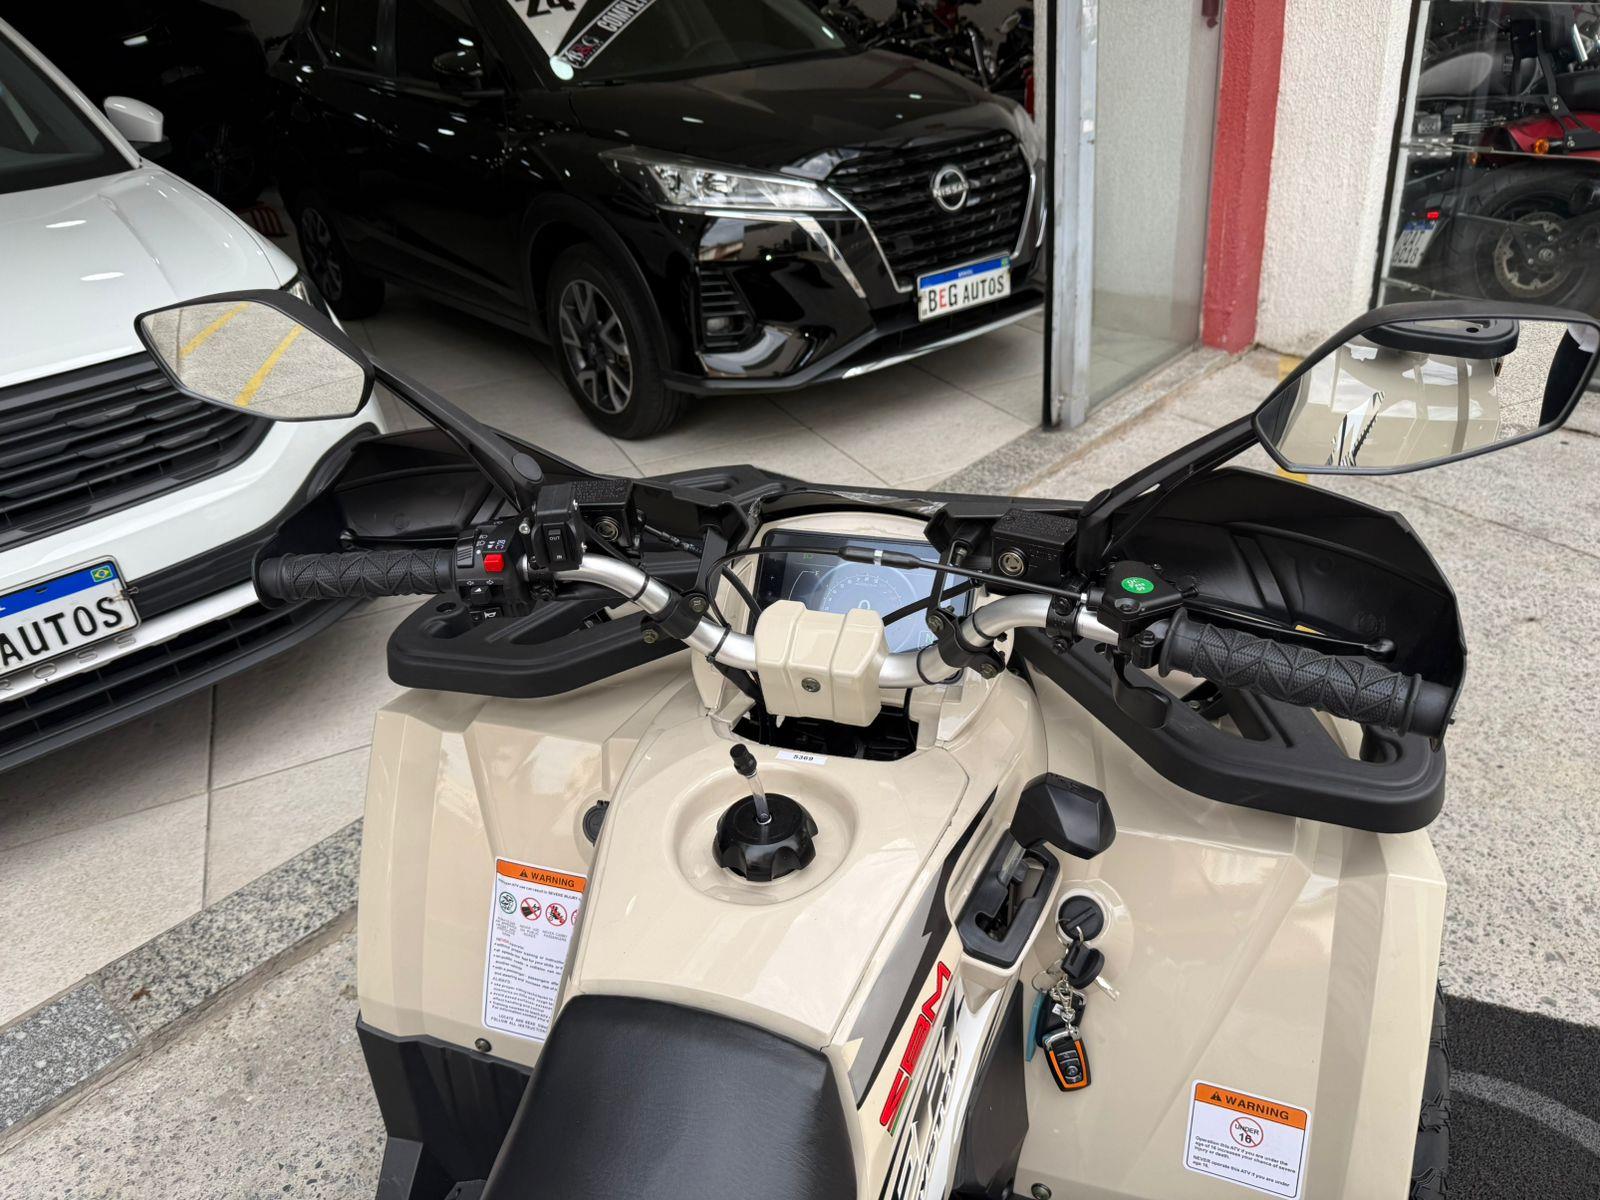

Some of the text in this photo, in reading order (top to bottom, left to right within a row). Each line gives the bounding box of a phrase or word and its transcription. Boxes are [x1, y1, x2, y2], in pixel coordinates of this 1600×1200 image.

[932, 181, 970, 198] NISSAN
[928, 274, 1005, 312] BEG AUTOS
[0, 596, 123, 667] AUTOS
[532, 872, 574, 887] WARNING
[1225, 1095, 1289, 1120] WARNING
[1234, 1124, 1259, 1135] UNDER
[1239, 1133, 1252, 1143] 16
[1254, 1157, 1271, 1167] chance
[1194, 1155, 1210, 1164] NEVER
[1212, 1160, 1229, 1170] operate
[1275, 1179, 1289, 1188] under
